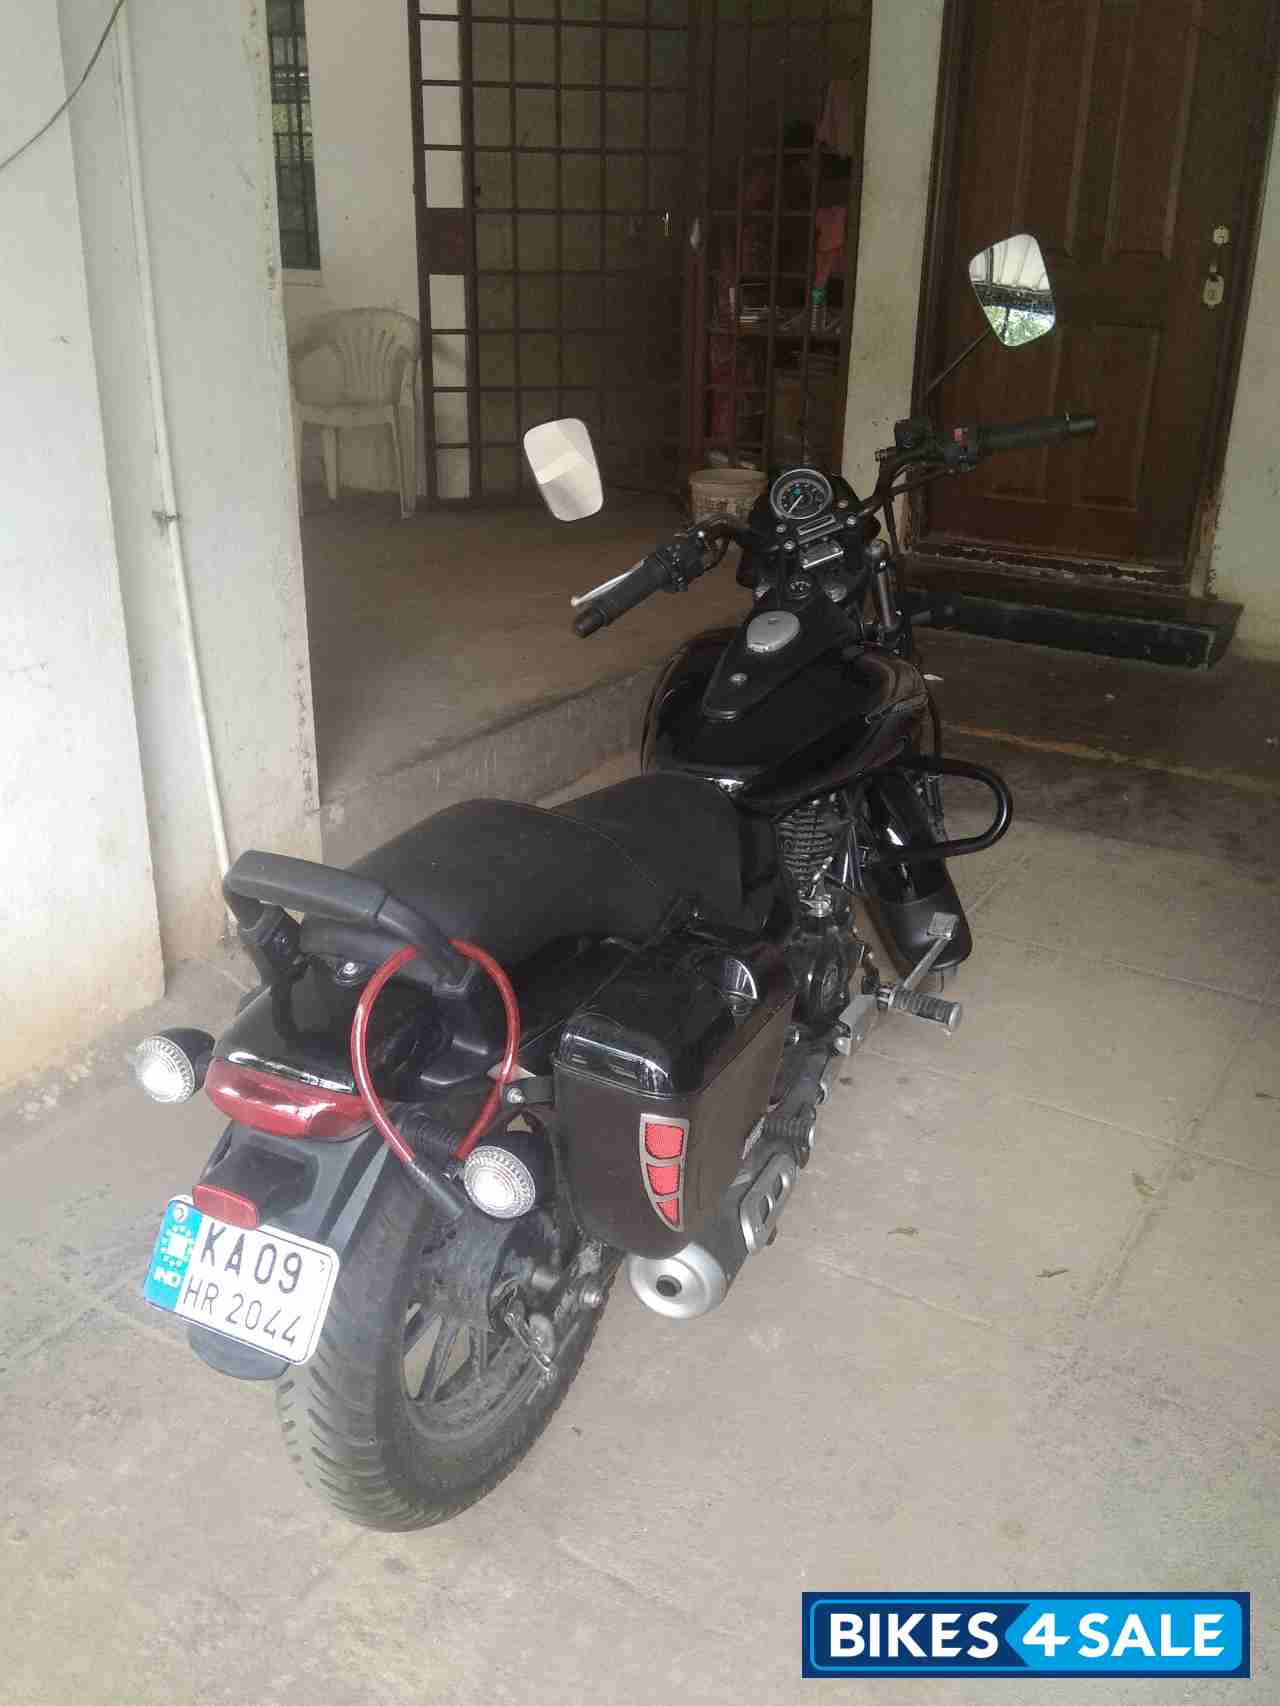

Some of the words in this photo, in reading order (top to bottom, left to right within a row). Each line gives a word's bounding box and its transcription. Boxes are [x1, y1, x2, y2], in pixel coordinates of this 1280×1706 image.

[201, 1222, 246, 1276] KA
[253, 1243, 303, 1294] 09
[183, 1276, 220, 1315] HR
[225, 1293, 301, 1347] 2044
